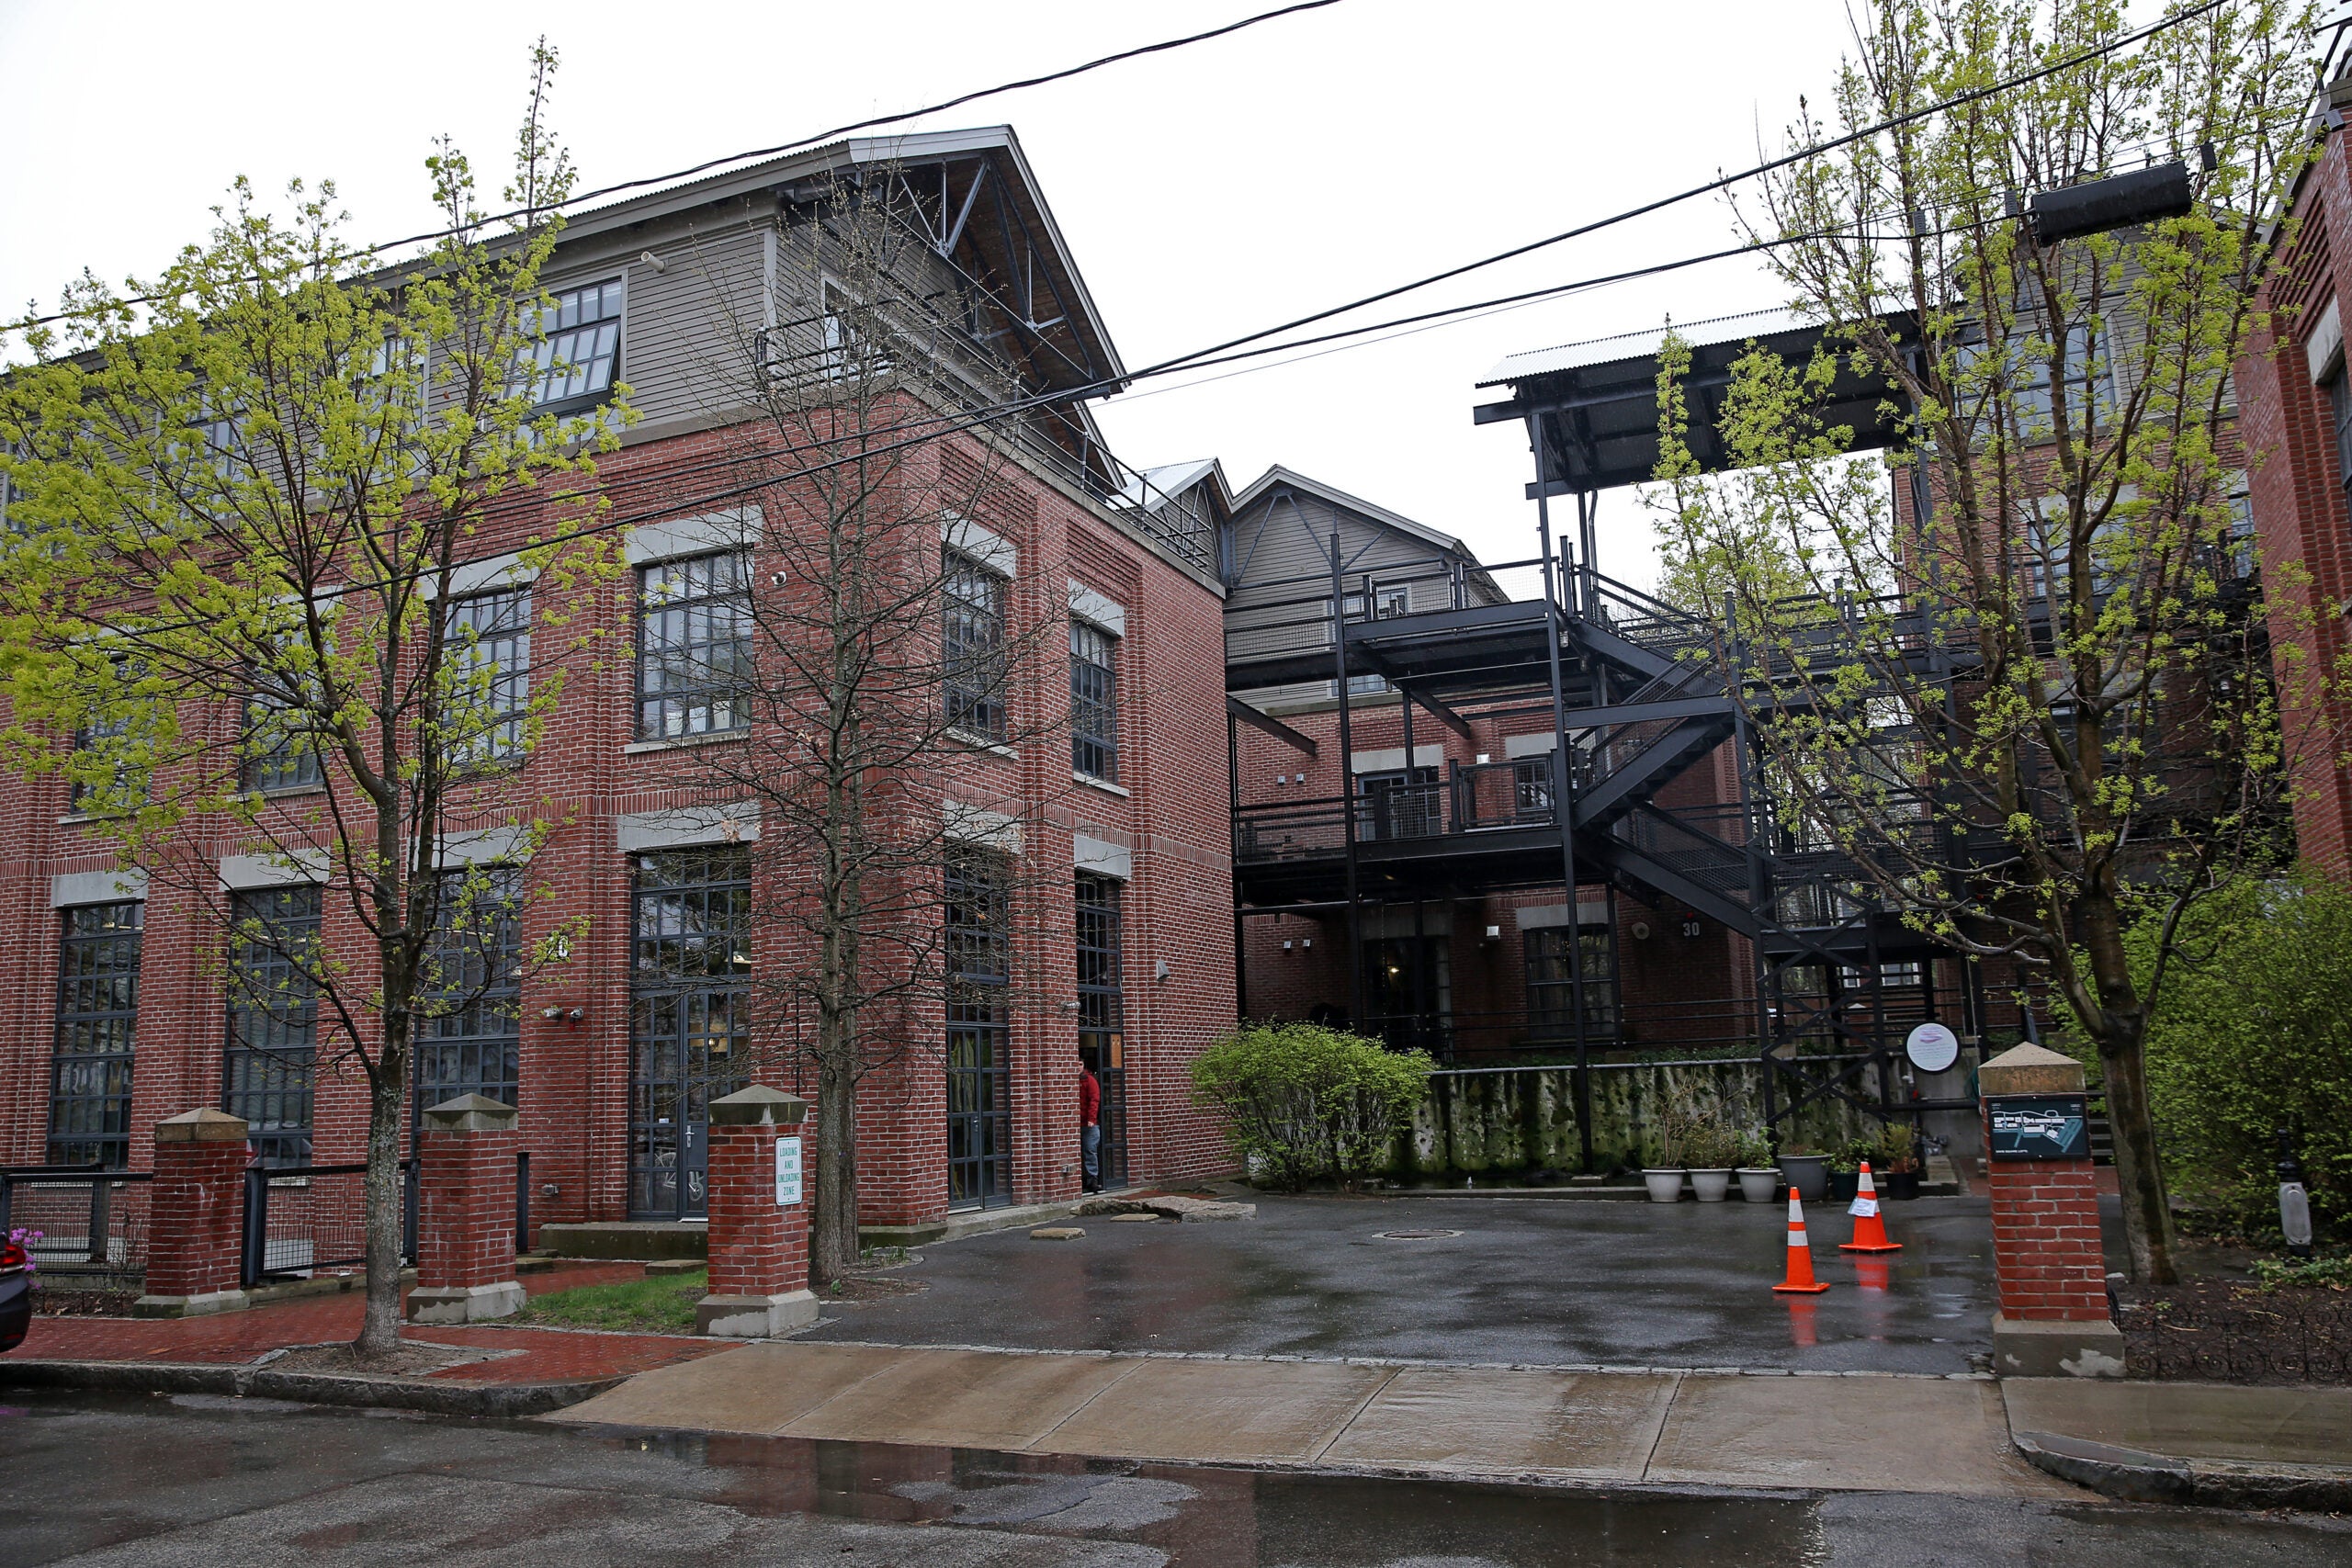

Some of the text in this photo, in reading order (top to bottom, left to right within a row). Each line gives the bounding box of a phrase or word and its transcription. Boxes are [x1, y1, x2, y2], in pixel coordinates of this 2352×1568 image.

[1682, 921, 1700, 936] 30
[779, 1146, 797, 1157] LOADING
[784, 1159, 794, 1169] AND
[777, 1172, 799, 1183] UNLOADING
[783, 1185, 795, 1196] ZONE
